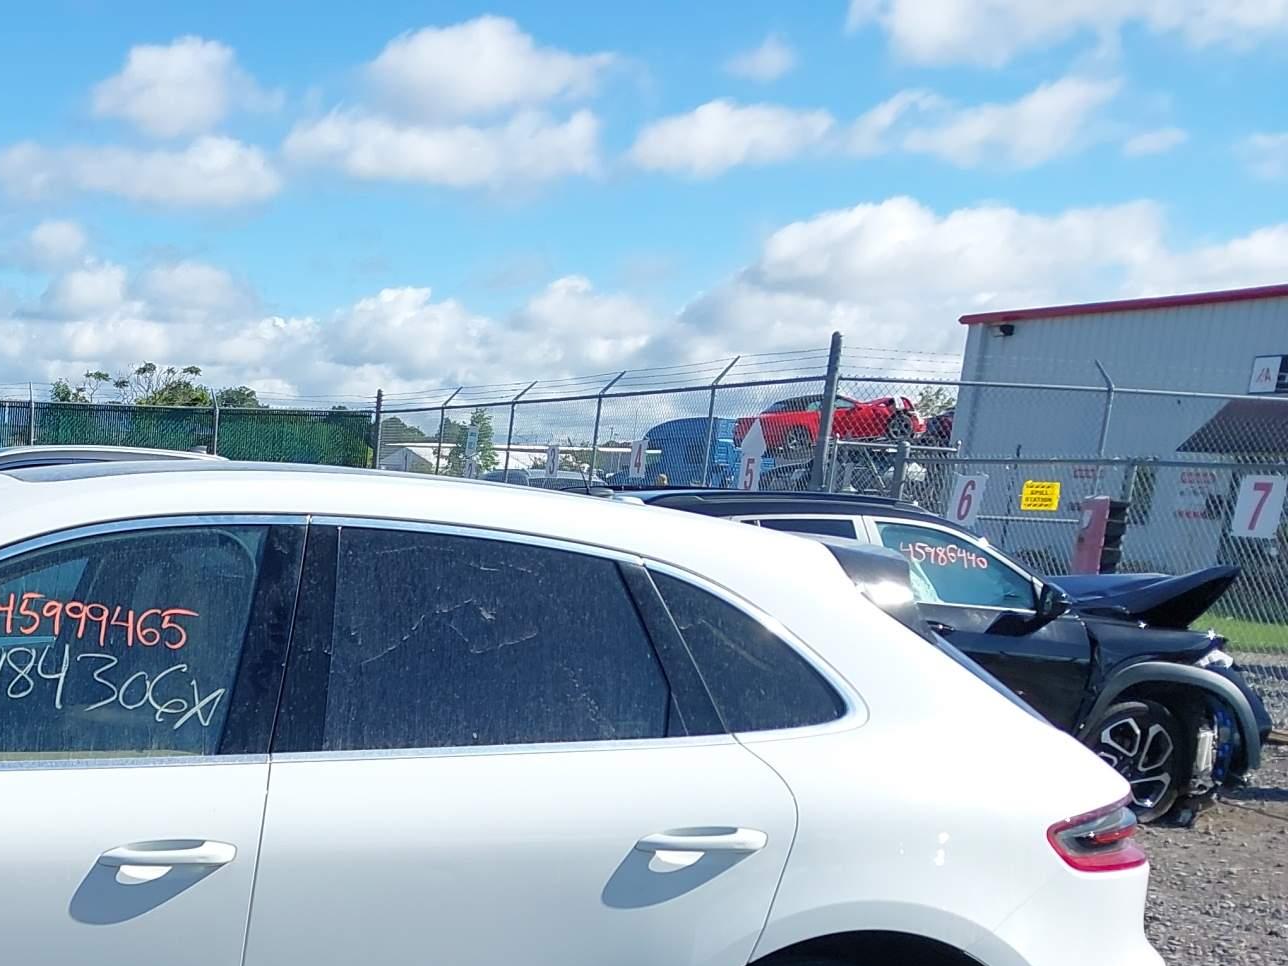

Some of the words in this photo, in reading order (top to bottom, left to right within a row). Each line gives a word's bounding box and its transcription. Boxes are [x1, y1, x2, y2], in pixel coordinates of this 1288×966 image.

[548, 447, 556, 475] 3
[633, 443, 642, 474] 4
[743, 457, 755, 491] 5
[956, 479, 977, 521] 6
[1247, 481, 1274, 531] 7
